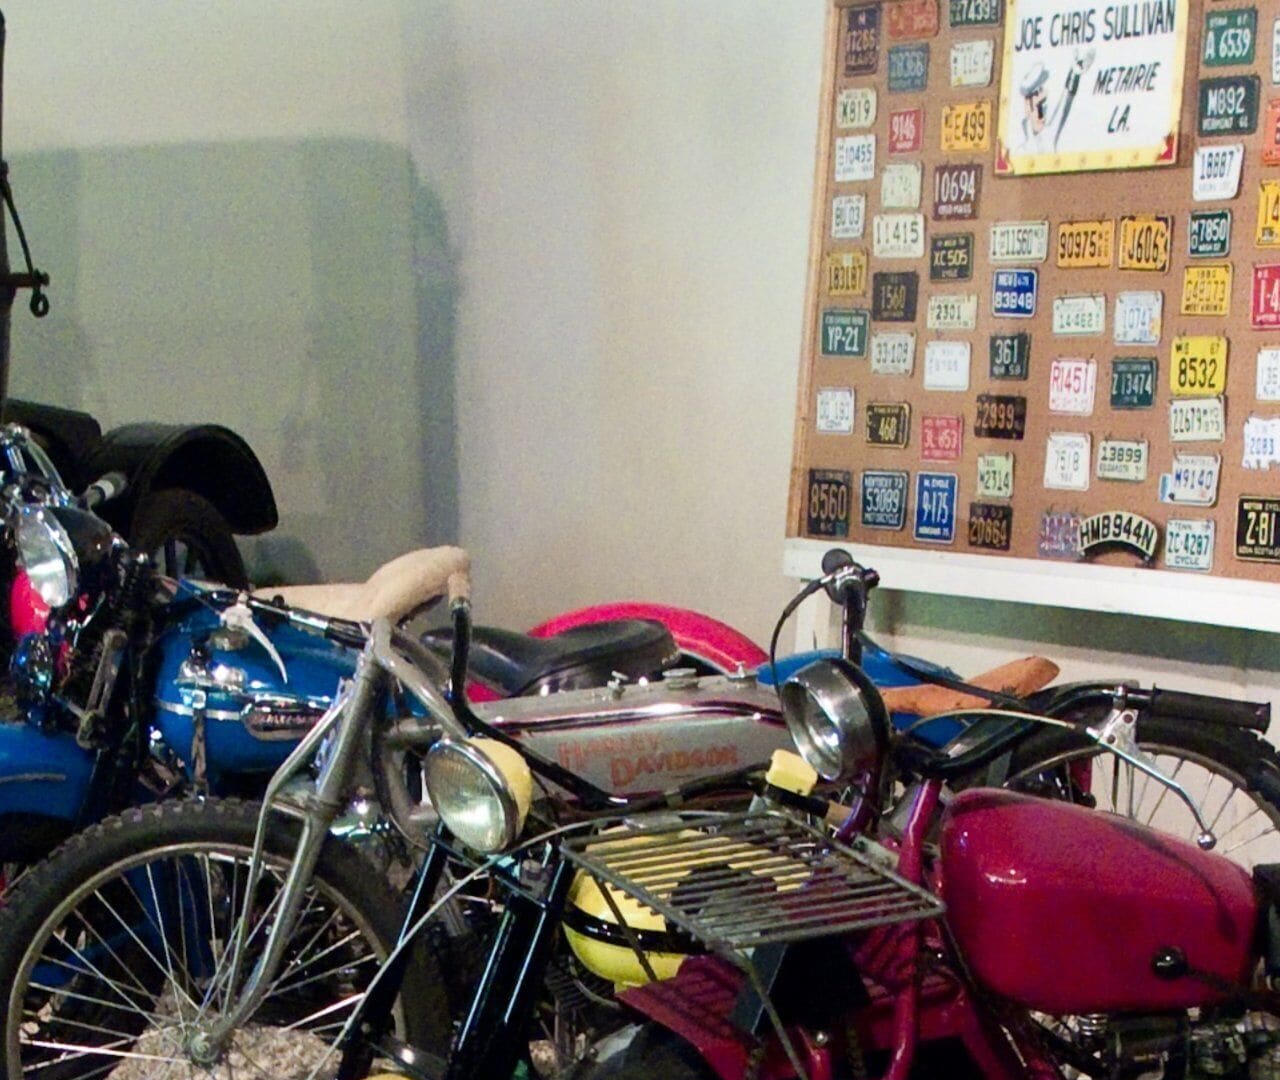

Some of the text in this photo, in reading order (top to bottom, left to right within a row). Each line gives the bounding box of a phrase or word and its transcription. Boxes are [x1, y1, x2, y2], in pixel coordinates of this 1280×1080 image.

[1015, 0, 1176, 51] JOE CHRIS SULLIVAN
[1093, 62, 1160, 95] METAIRIE
[1107, 104, 1130, 133] LA.
[1178, 358, 1218, 388] 8532
[1080, 514, 1156, 551] HMB944N
